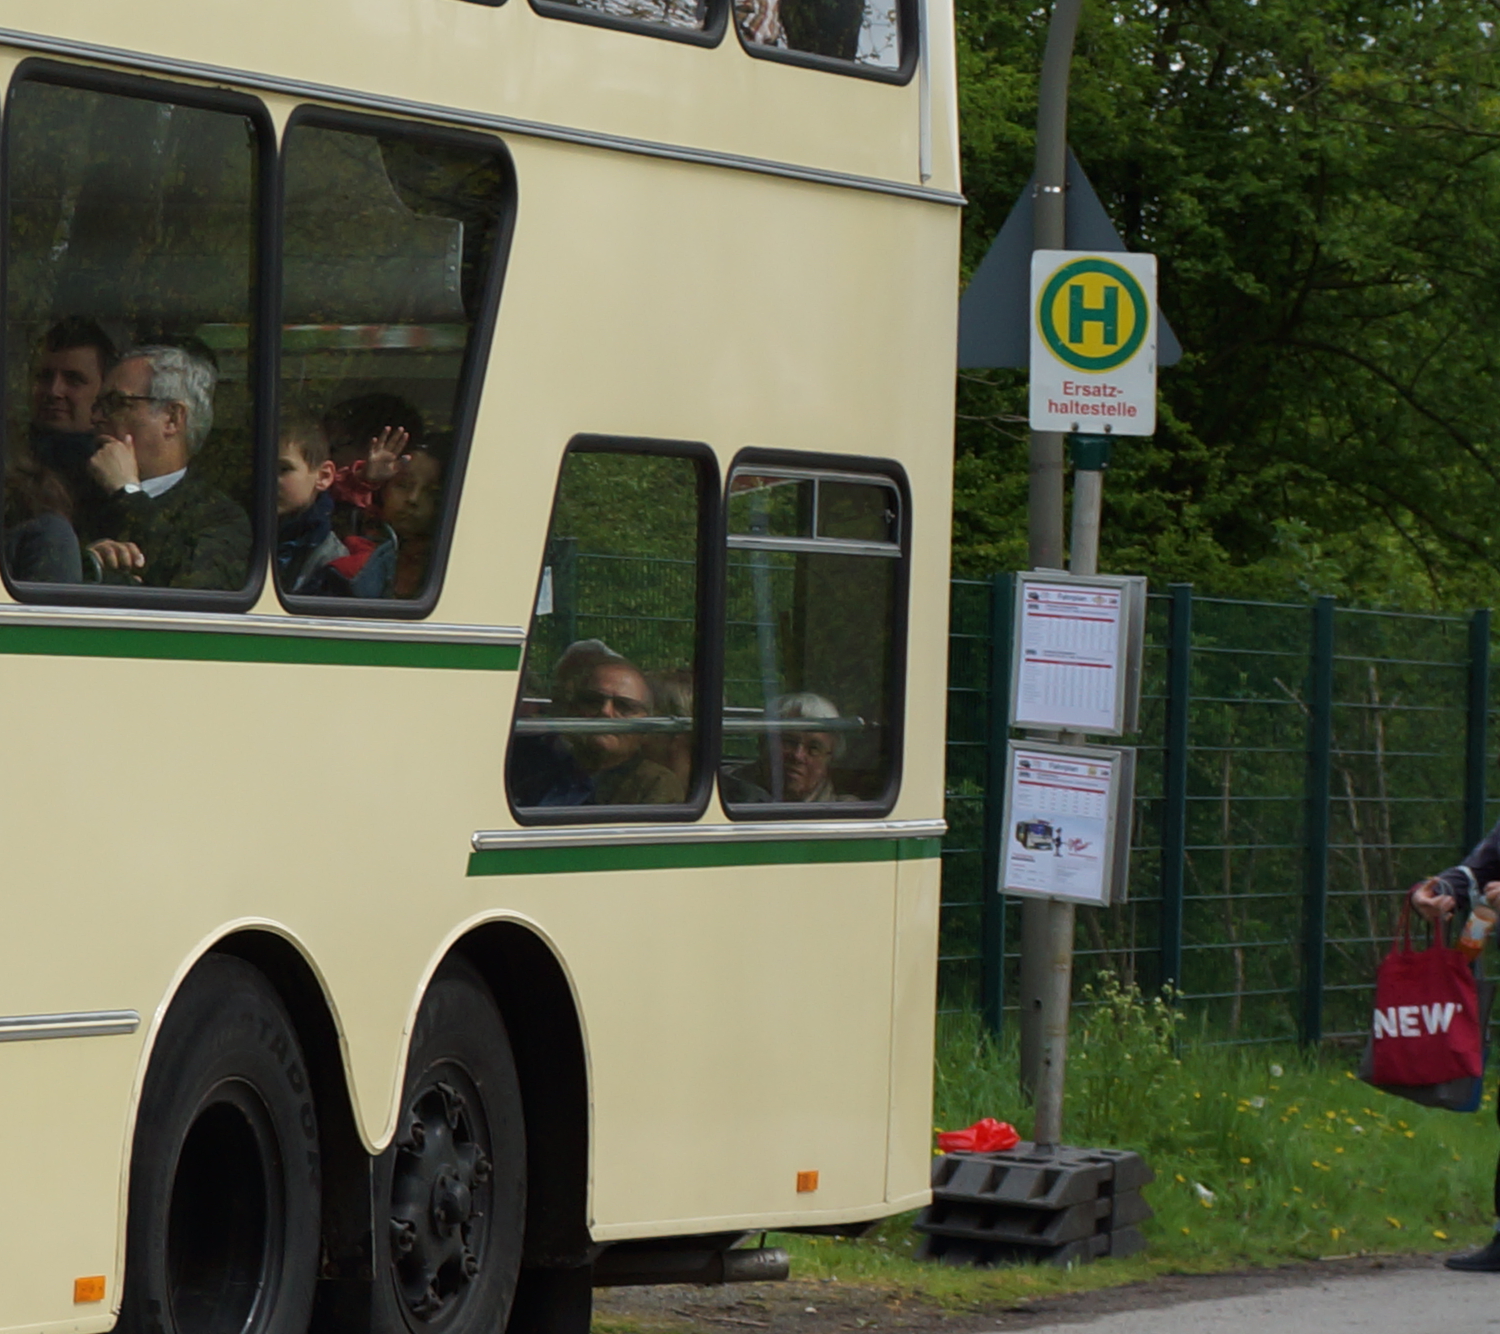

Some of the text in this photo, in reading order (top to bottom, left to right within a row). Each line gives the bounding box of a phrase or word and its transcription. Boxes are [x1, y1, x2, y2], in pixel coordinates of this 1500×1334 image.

[1068, 284, 1119, 345] H
[1062, 381, 1125, 397] Ersatz-
[1047, 399, 1137, 417] haltestelle
